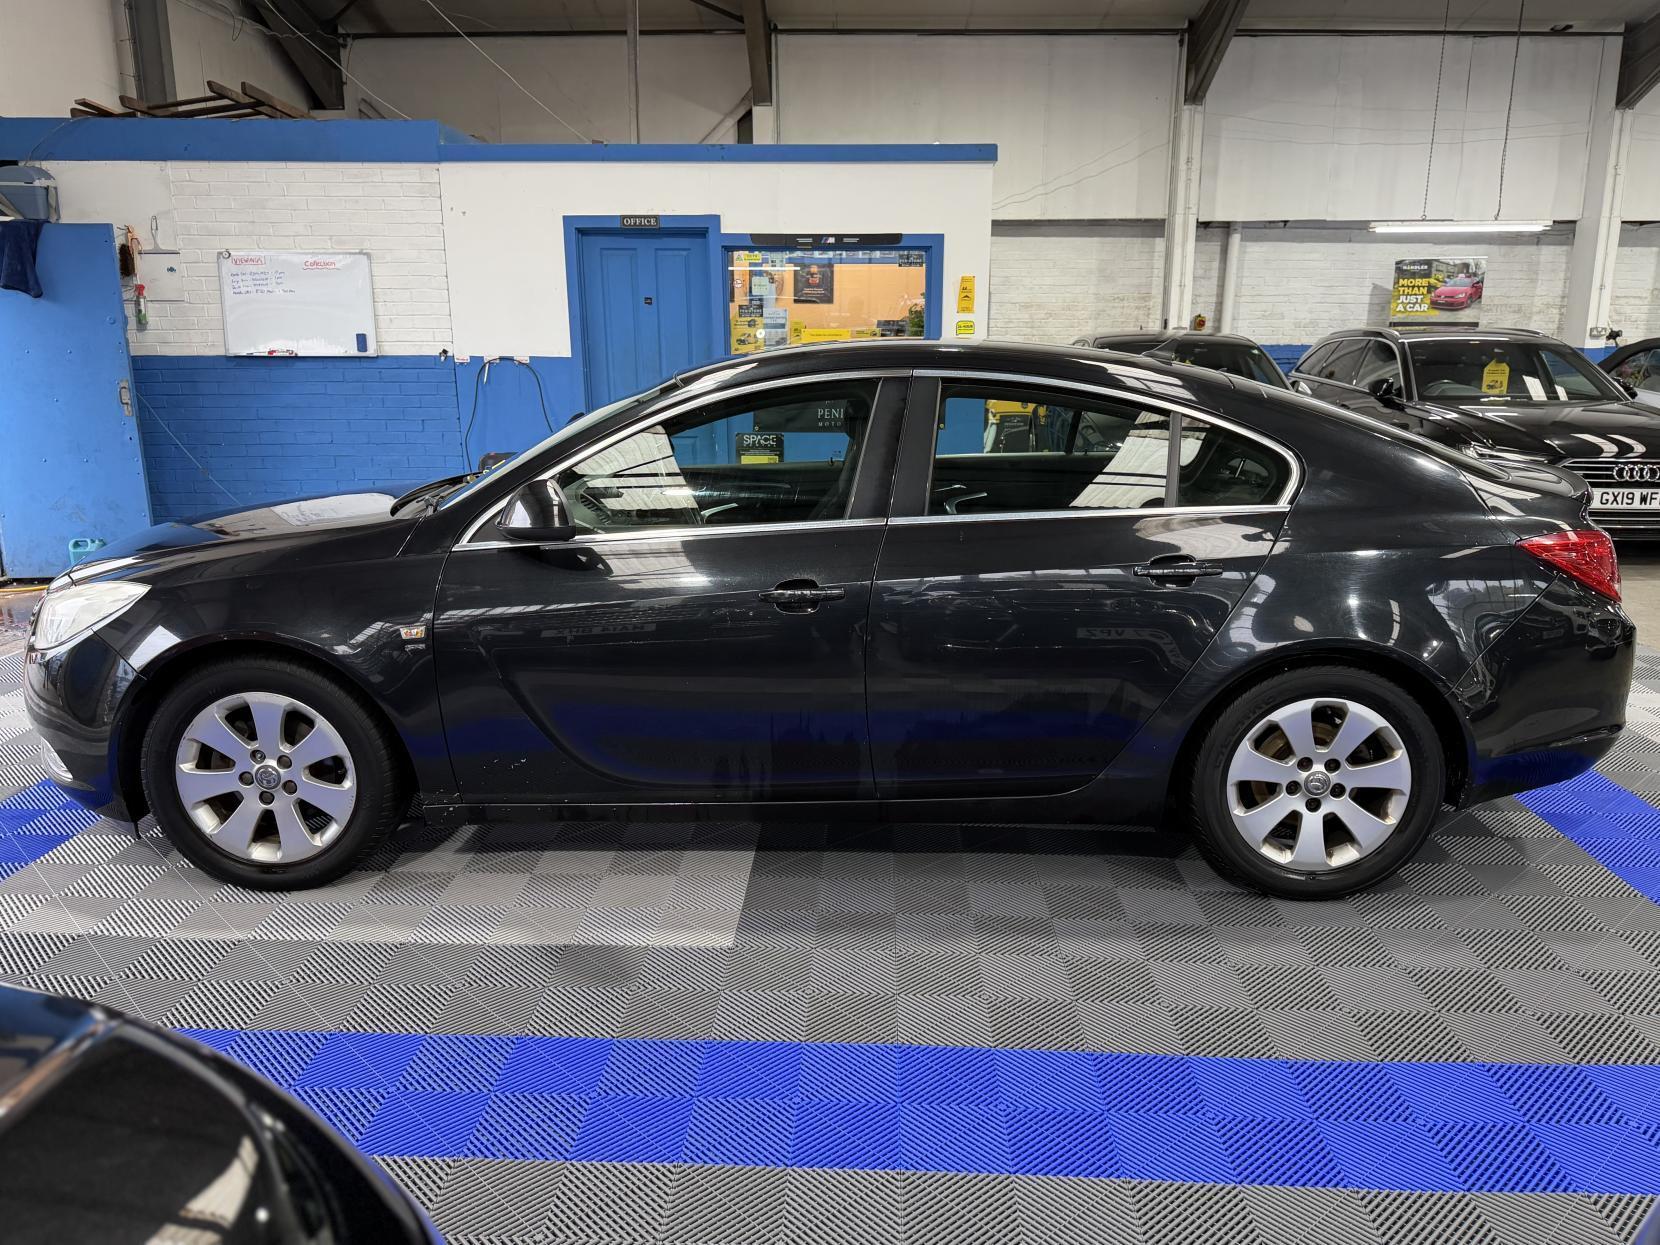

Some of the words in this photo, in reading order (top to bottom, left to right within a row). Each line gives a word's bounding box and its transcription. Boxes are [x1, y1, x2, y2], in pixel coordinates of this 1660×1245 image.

[624, 217, 657, 226] OFFICE
[1398, 278, 1429, 286] MORE
[1398, 287, 1428, 295] THAN
[1397, 295, 1424, 303] JUST
[1396, 303, 1405, 312] A
[1405, 303, 1429, 312] CAR
[743, 434, 777, 445] SPACE
[1599, 491, 1635, 506] GX19
[1639, 491, 1660, 506] WF
